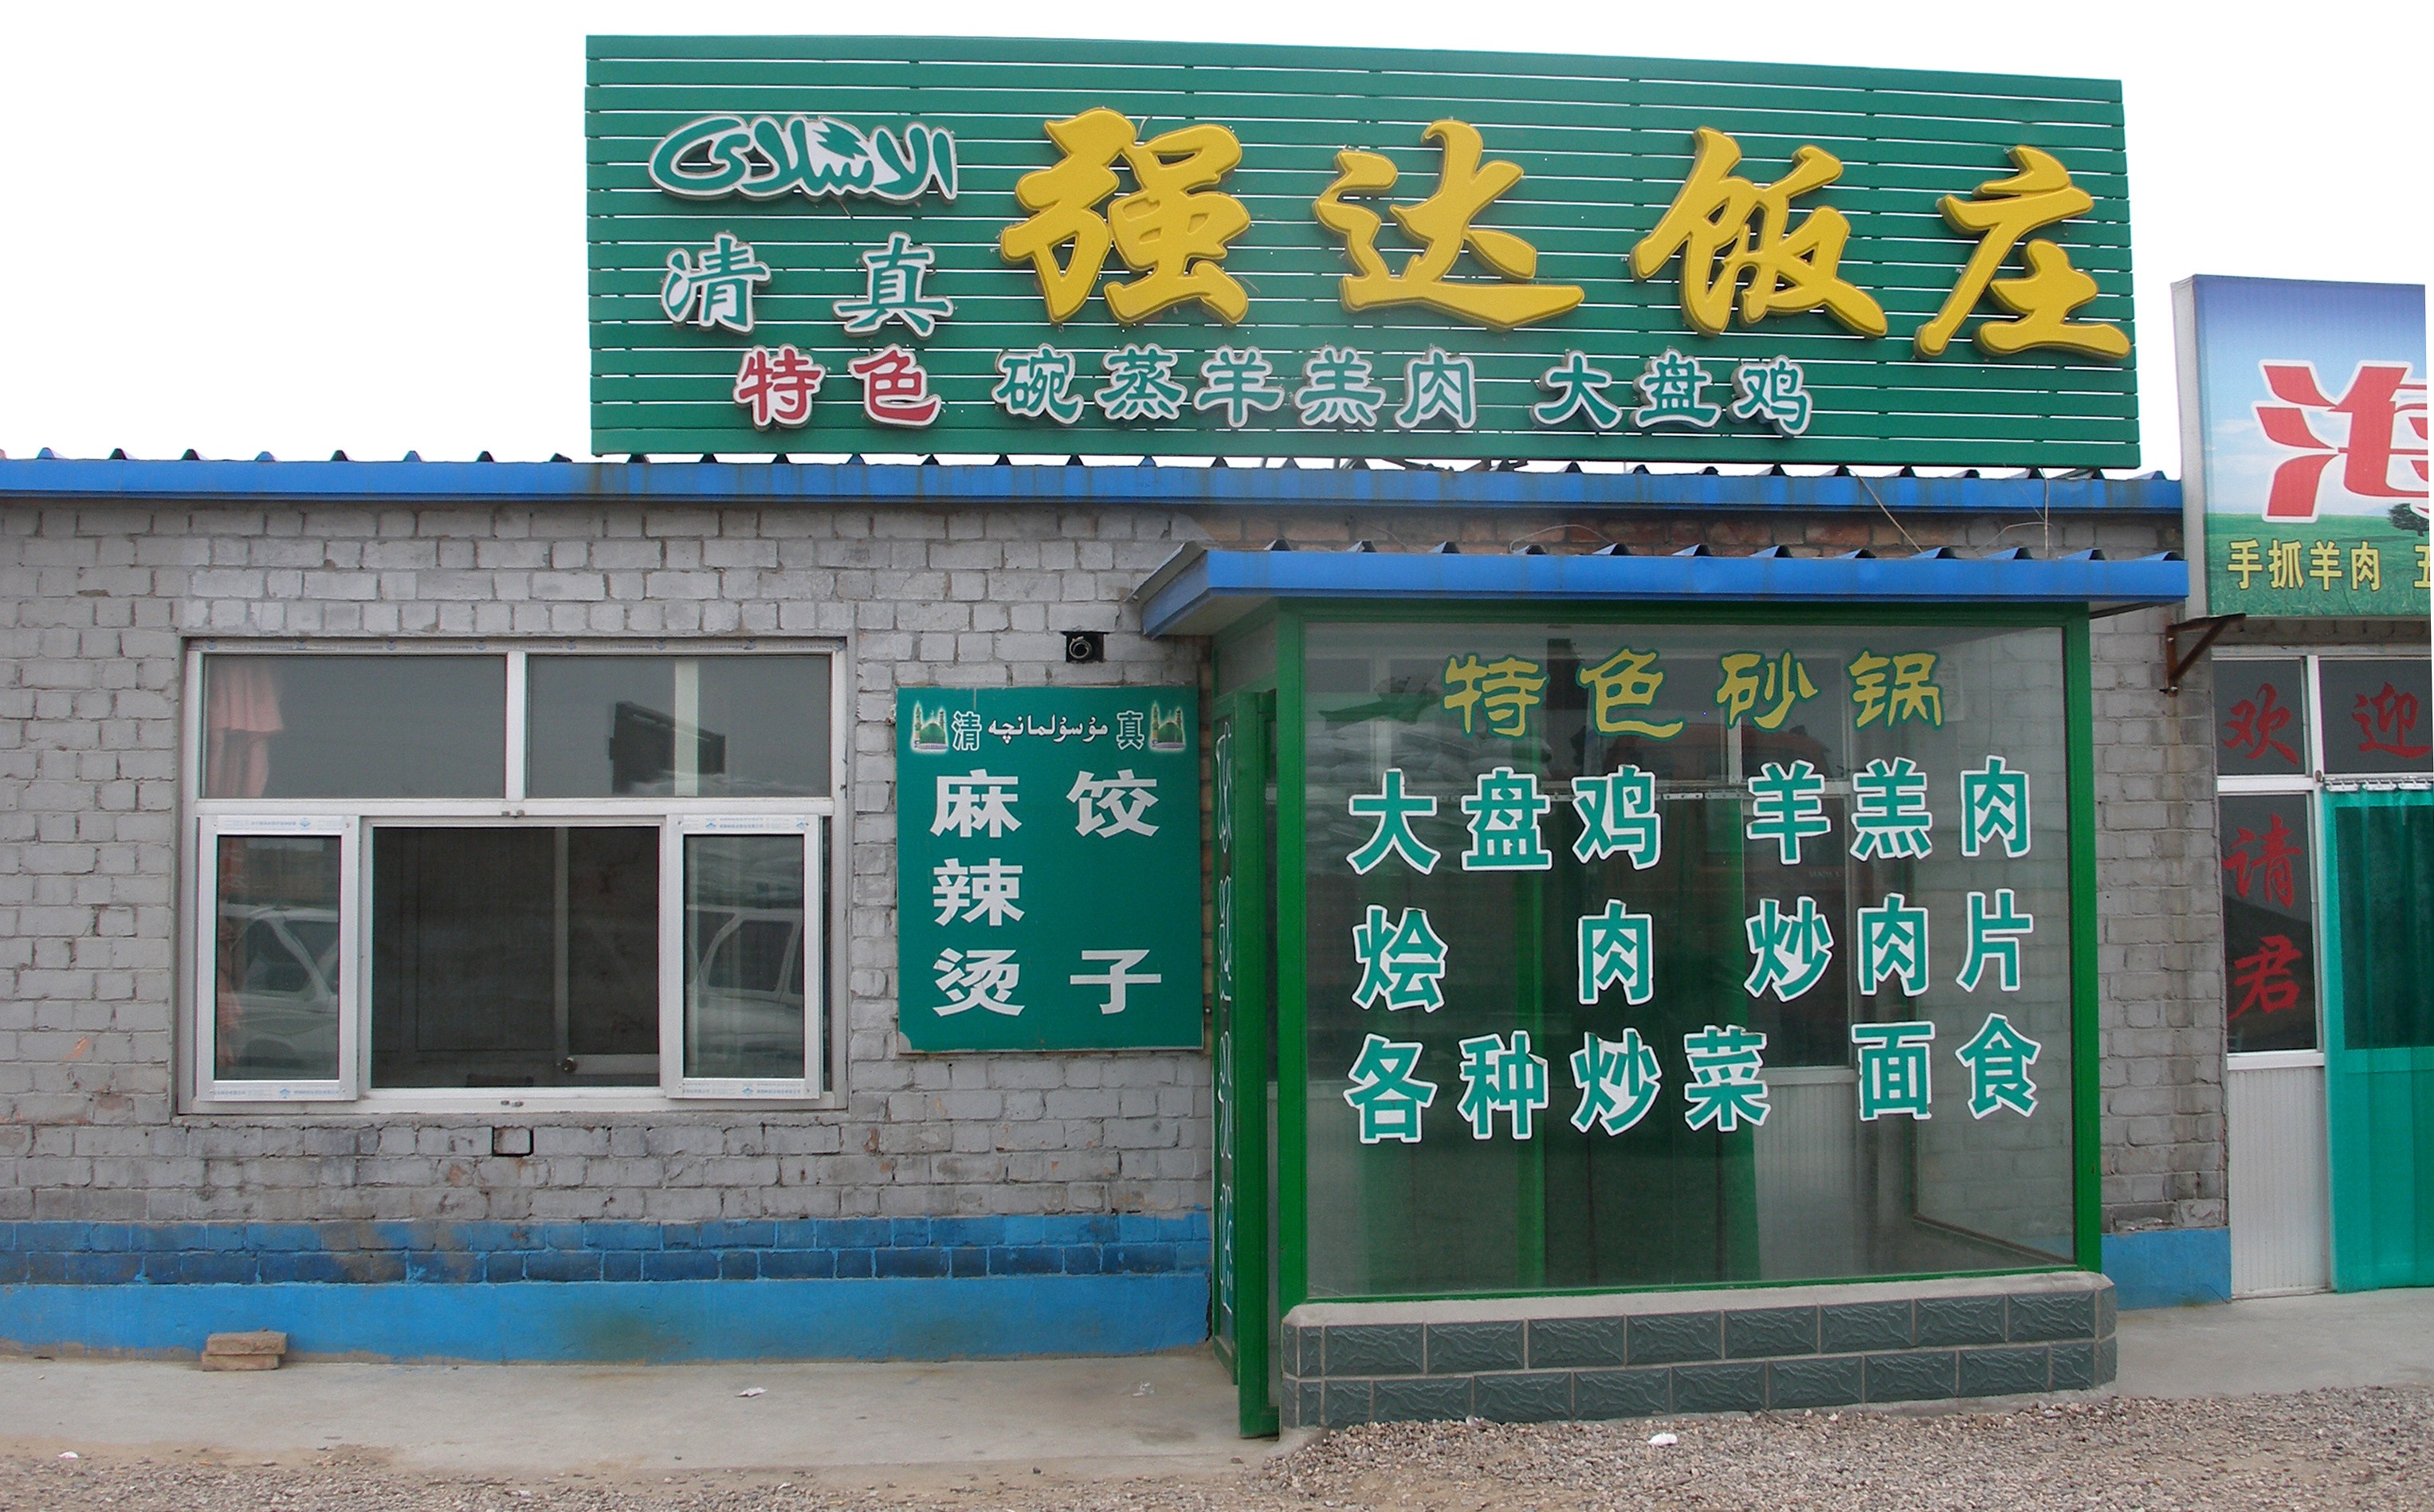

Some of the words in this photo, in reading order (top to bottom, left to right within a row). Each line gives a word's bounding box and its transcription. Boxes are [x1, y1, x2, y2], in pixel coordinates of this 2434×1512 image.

[661, 232, 954, 339] 清真
[1000, 107, 2132, 360] 强达饭庄
[734, 343, 945, 430] 特色
[993, 343, 1479, 430] 碗蒸羊羔肉
[1530, 347, 1812, 436] 大盘鸡
[2227, 537, 2381, 591] 手抓羊肉
[951, 710, 982, 751] 清
[1117, 710, 1144, 751] 真
[1443, 646, 1945, 737] 特色砂锅
[1347, 765, 1661, 874] 大盘鸡
[1746, 756, 2031, 865] 羊羔肉
[929, 768, 1026, 1017] 麻辣烫
[1066, 768, 1162, 1015] 饺子
[1352, 900, 1654, 1011] 烩肉
[1745, 889, 2033, 1001] 炒肉片
[2222, 813, 2302, 1020] 请君
[1344, 1024, 1771, 1143] 各种炒菜
[1851, 1013, 2042, 1120] 面食
